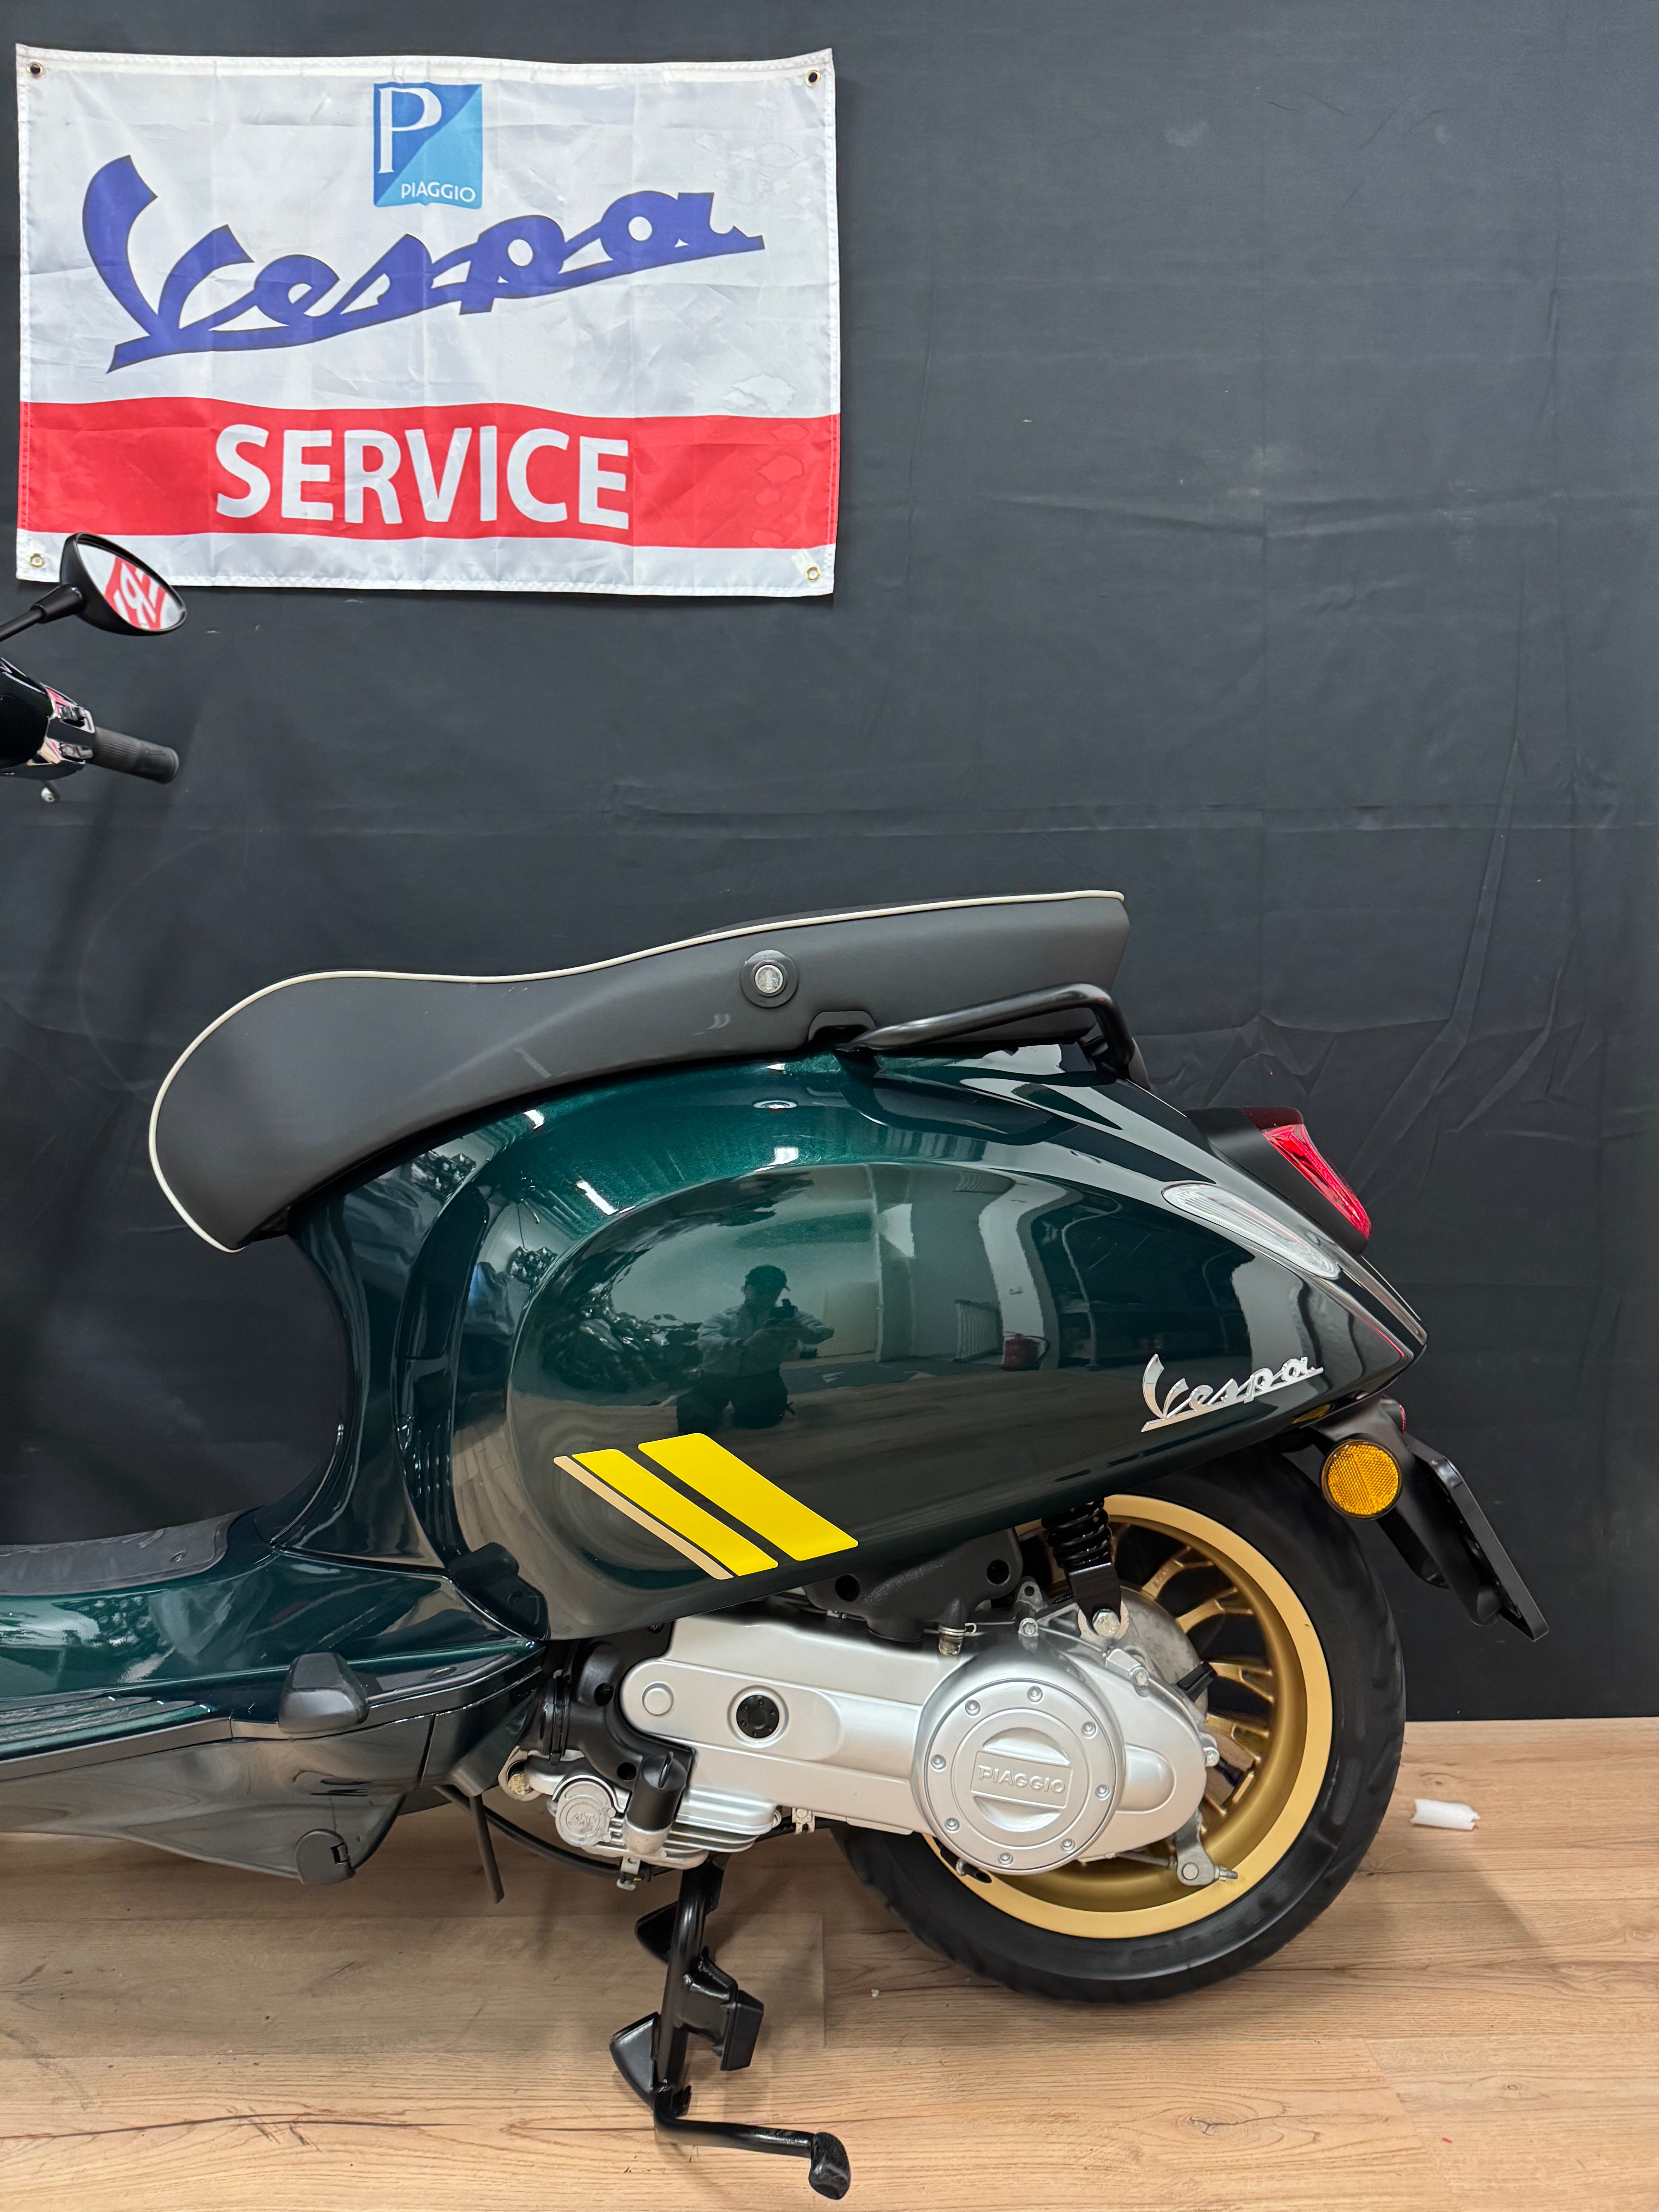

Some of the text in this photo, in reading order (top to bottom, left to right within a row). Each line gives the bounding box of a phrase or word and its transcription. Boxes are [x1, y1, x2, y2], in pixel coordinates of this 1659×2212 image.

[378, 87, 442, 174] P
[401, 181, 476, 203] PIAGGIO
[83, 156, 764, 373] Vespa
[216, 424, 629, 530] SERVICE
[1141, 1354, 1323, 1432] Vespa
[978, 1765, 1065, 1793] PIAGGIO
